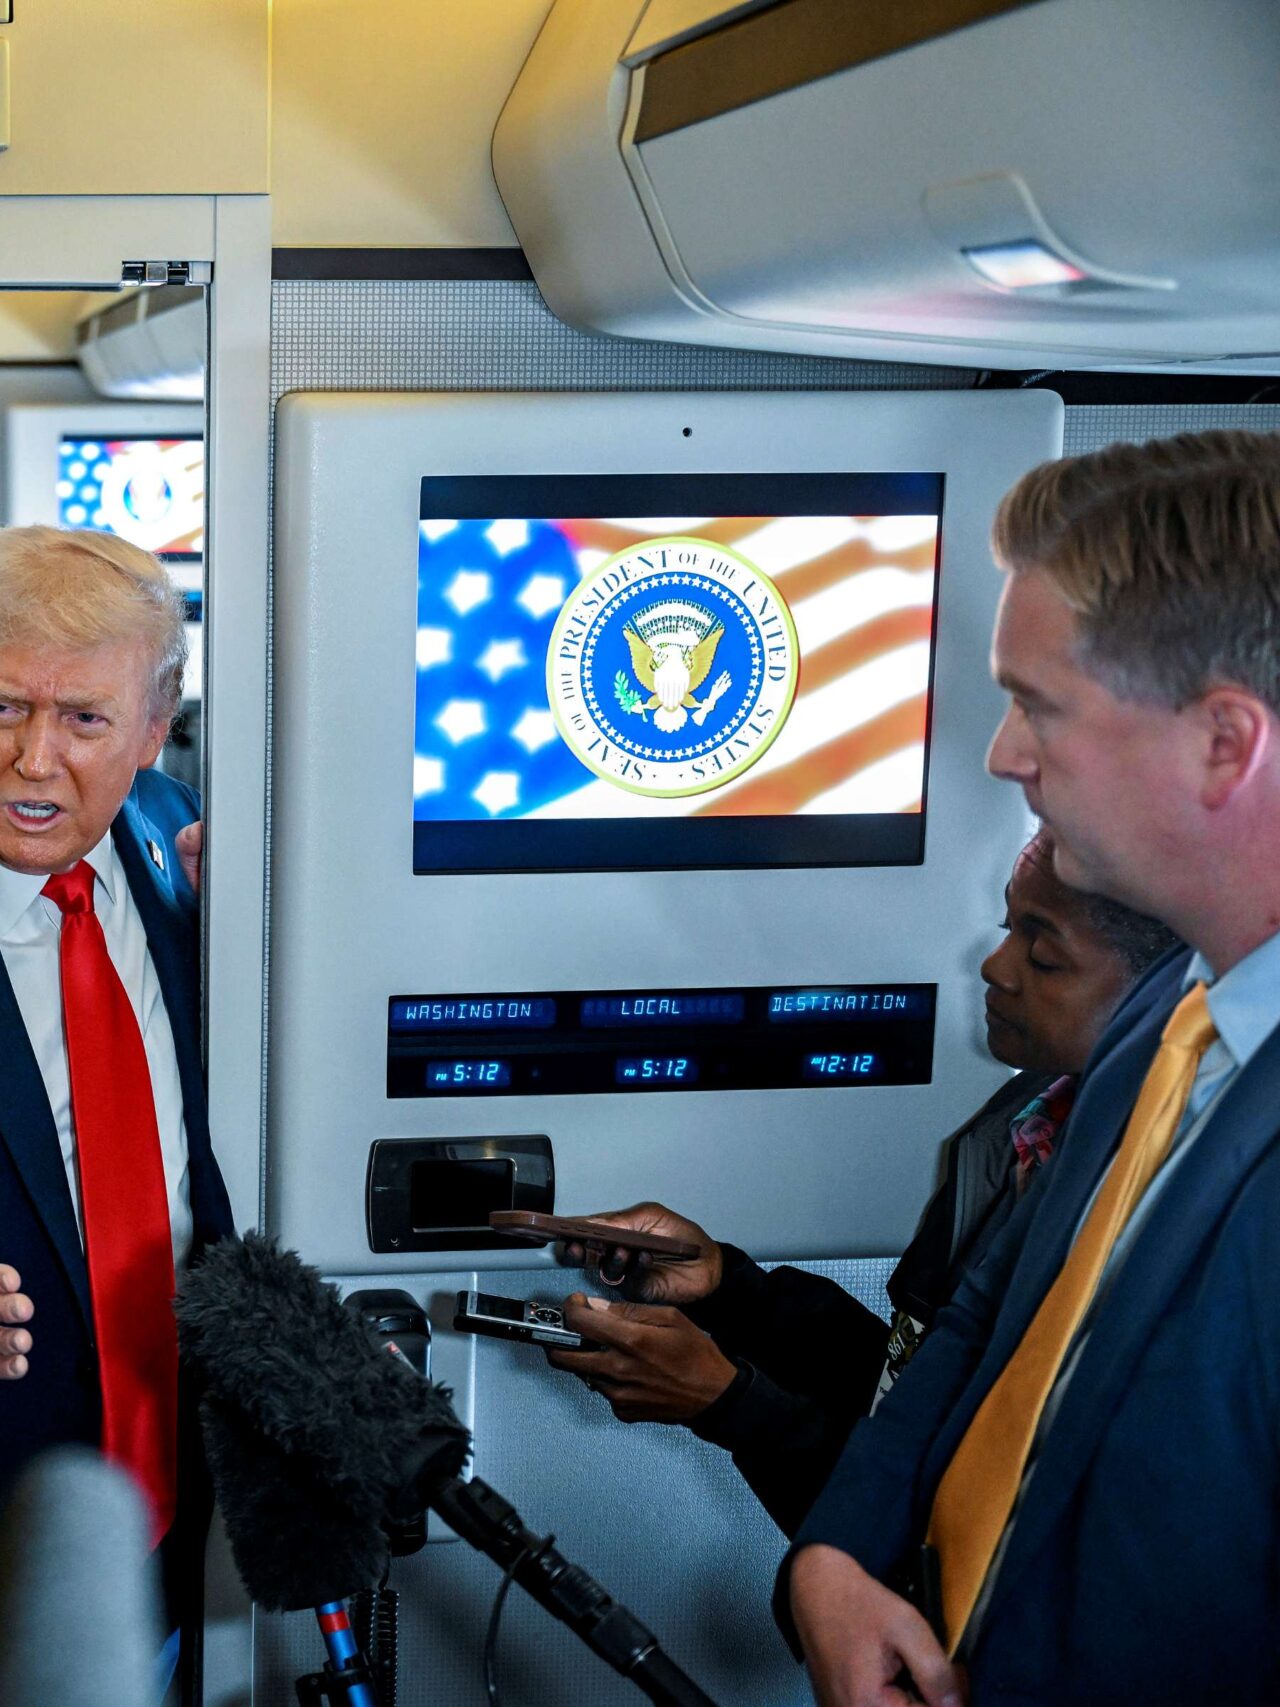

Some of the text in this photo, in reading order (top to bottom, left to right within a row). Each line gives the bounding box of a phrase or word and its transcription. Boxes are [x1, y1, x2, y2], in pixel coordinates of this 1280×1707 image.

[406, 1003, 531, 1020] WASHINGTON
[621, 999, 680, 1015] LOCAL
[772, 994, 906, 1012] DESTINATION
[435, 1063, 499, 1082] PM 5:12
[624, 1059, 687, 1077] PM 5:12
[820, 1055, 873, 1073] 12:12
